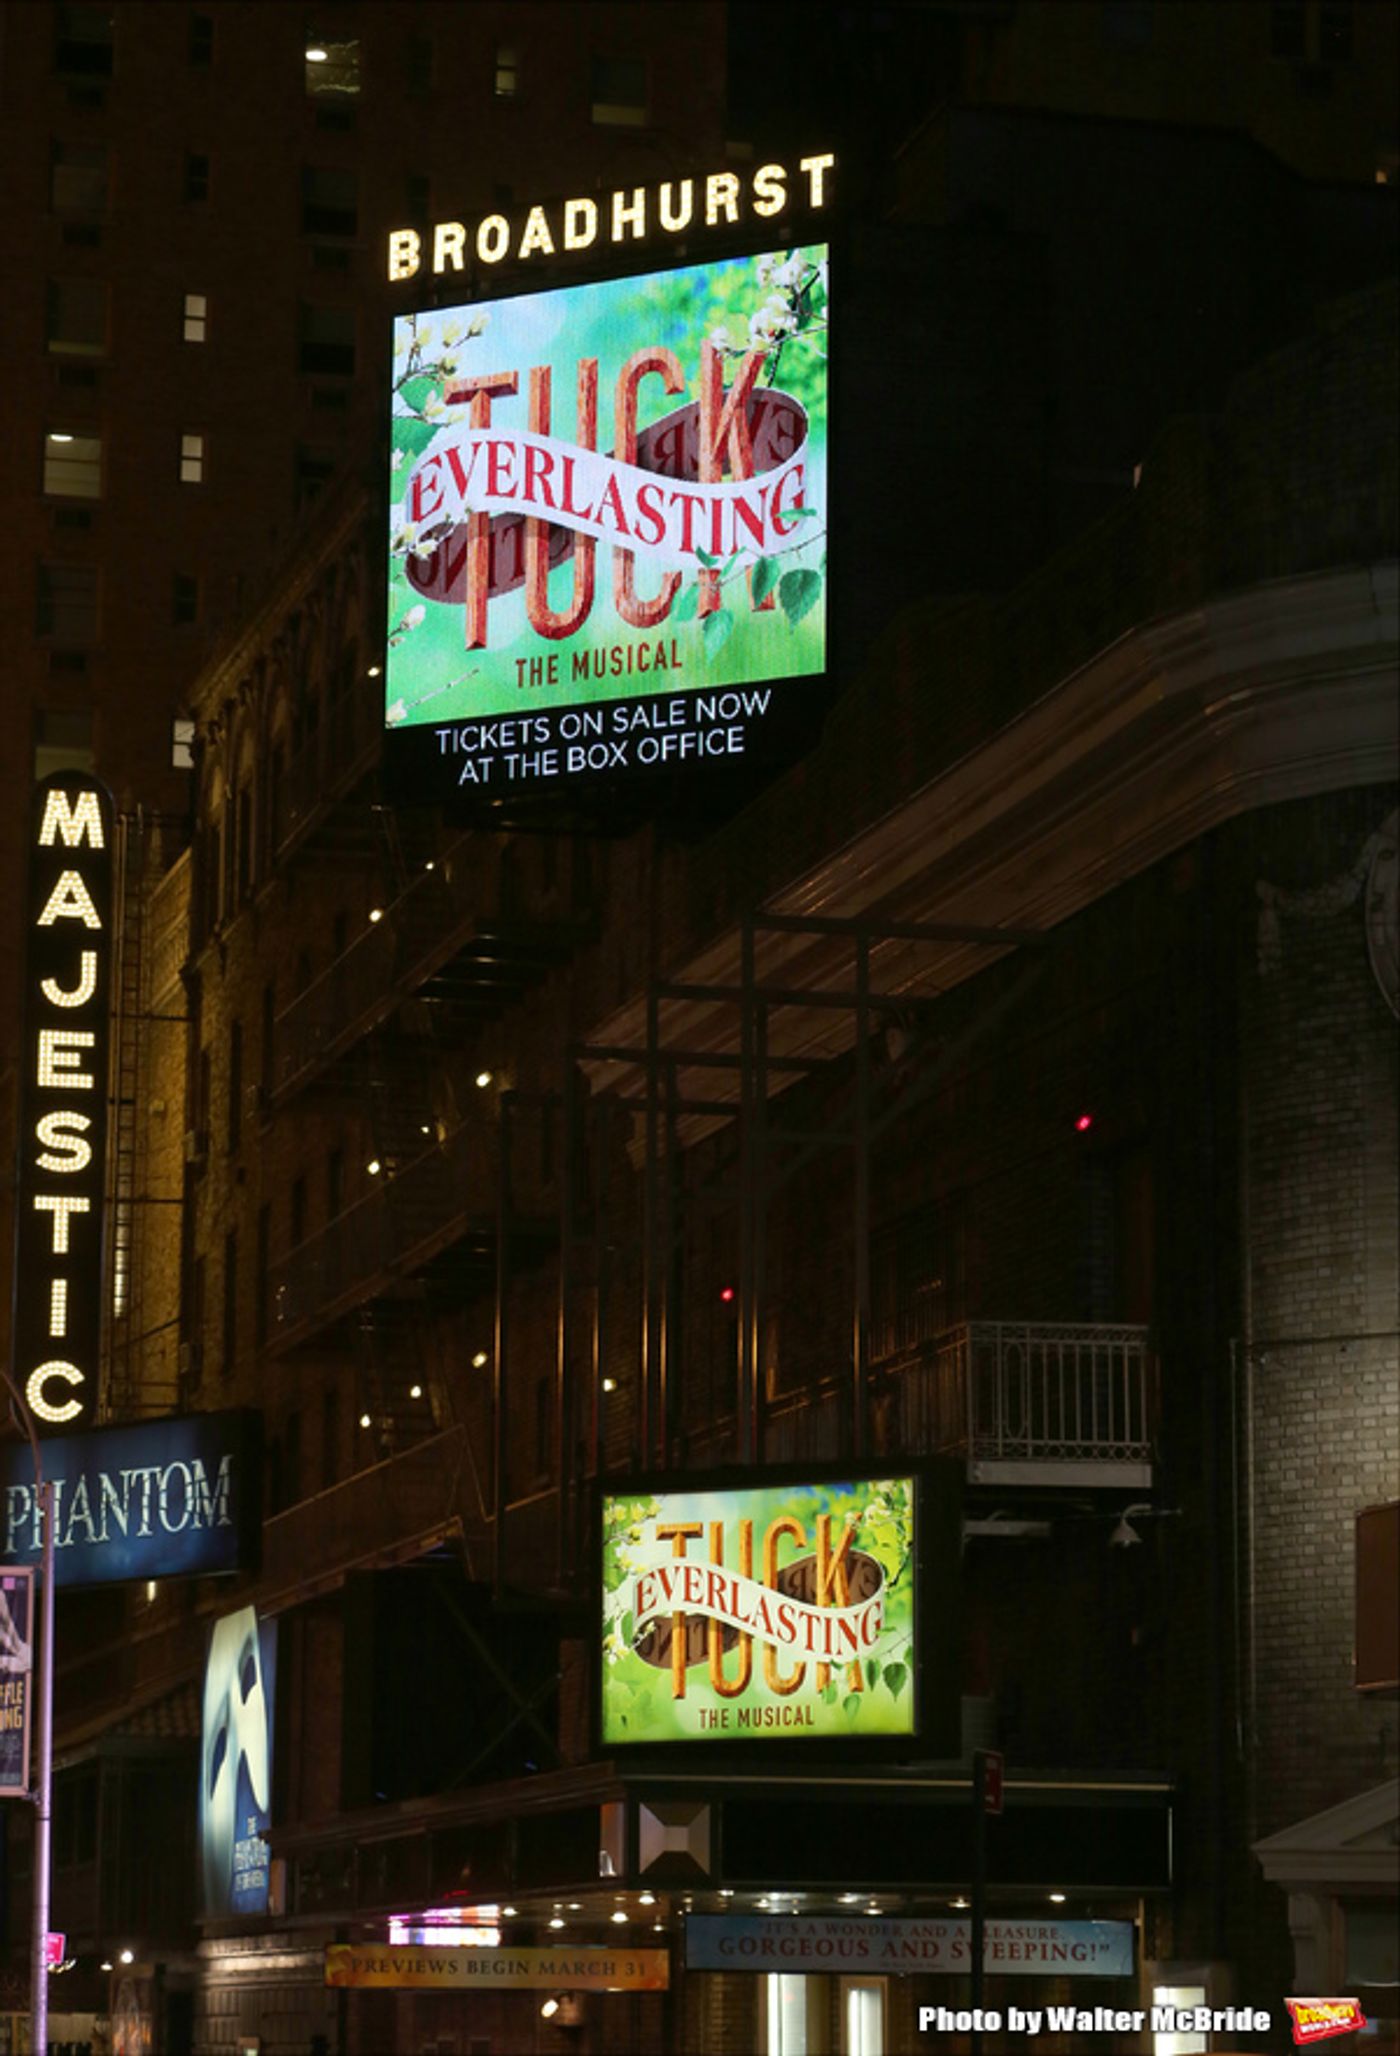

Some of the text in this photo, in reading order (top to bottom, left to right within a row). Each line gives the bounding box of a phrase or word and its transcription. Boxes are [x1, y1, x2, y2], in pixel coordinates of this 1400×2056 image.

[389, 153, 835, 281] BROADHURST
[411, 440, 807, 557] EVERLASTING
[443, 339, 776, 650] TUCK
[515, 639, 684, 688] THE MUSICAL
[435, 689, 772, 755] TICKETS ON SALE NOW
[458, 726, 746, 786] AT THE BOX OFFICE
[26, 789, 104, 1424] MAJESTIC
[4, 1454, 235, 1554] PHANTOM
[635, 1565, 883, 1656] EVERLASTING
[655, 1512, 865, 1700] TUCK
[699, 1705, 815, 1729] THE MUSICAL
[351, 1958, 646, 1977] PREVIEWS BEGIN MARCH 31
[718, 1935, 870, 1957] GORGEOUS
[880, 1940, 941, 1960] AND
[806, 1922, 817, 1935] A
[825, 1923, 903, 1937] WONDER
[910, 1925, 948, 1938] AND
[954, 1925, 966, 1938] A
